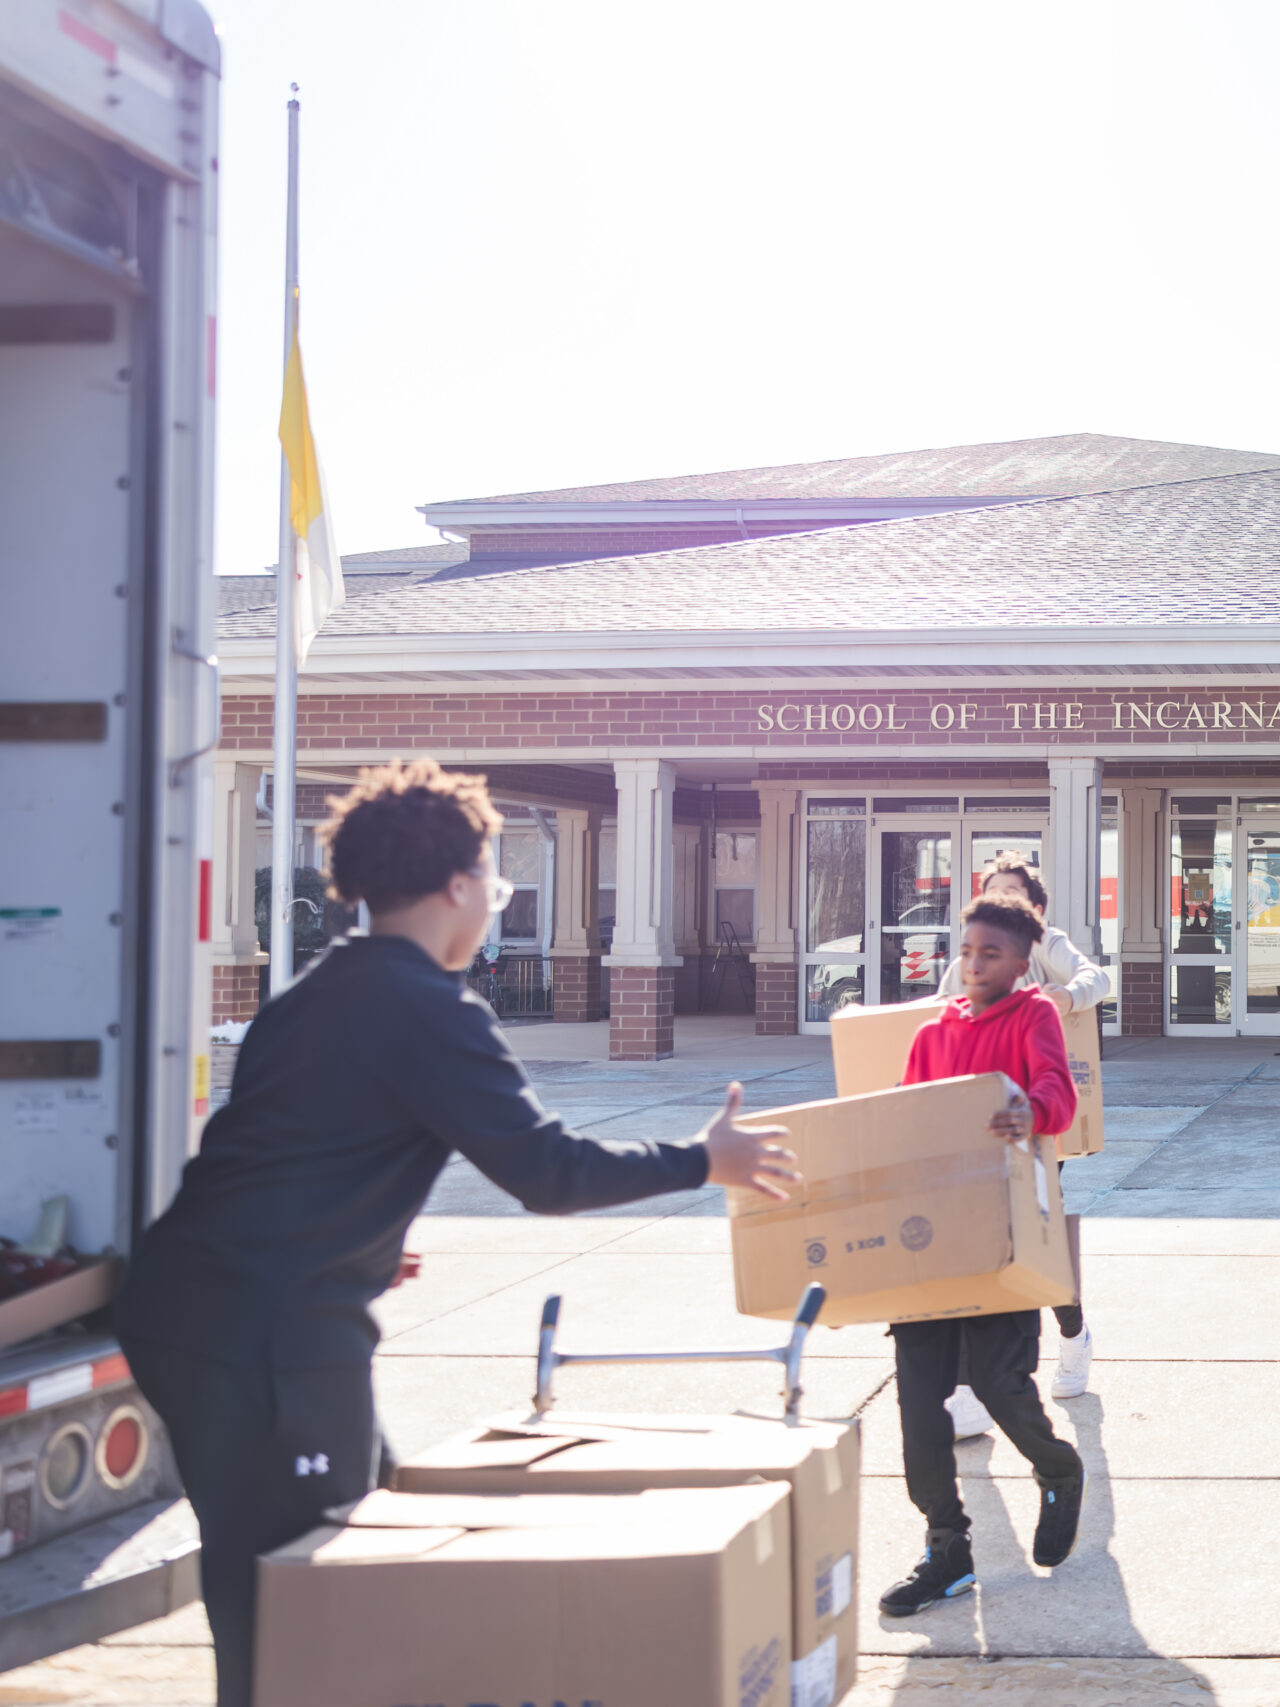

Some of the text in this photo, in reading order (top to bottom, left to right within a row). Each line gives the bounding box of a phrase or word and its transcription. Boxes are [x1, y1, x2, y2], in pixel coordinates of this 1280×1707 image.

[757, 704, 907, 731] SCHOOL
[930, 703, 978, 730] OF
[1006, 702, 1085, 729] THE
